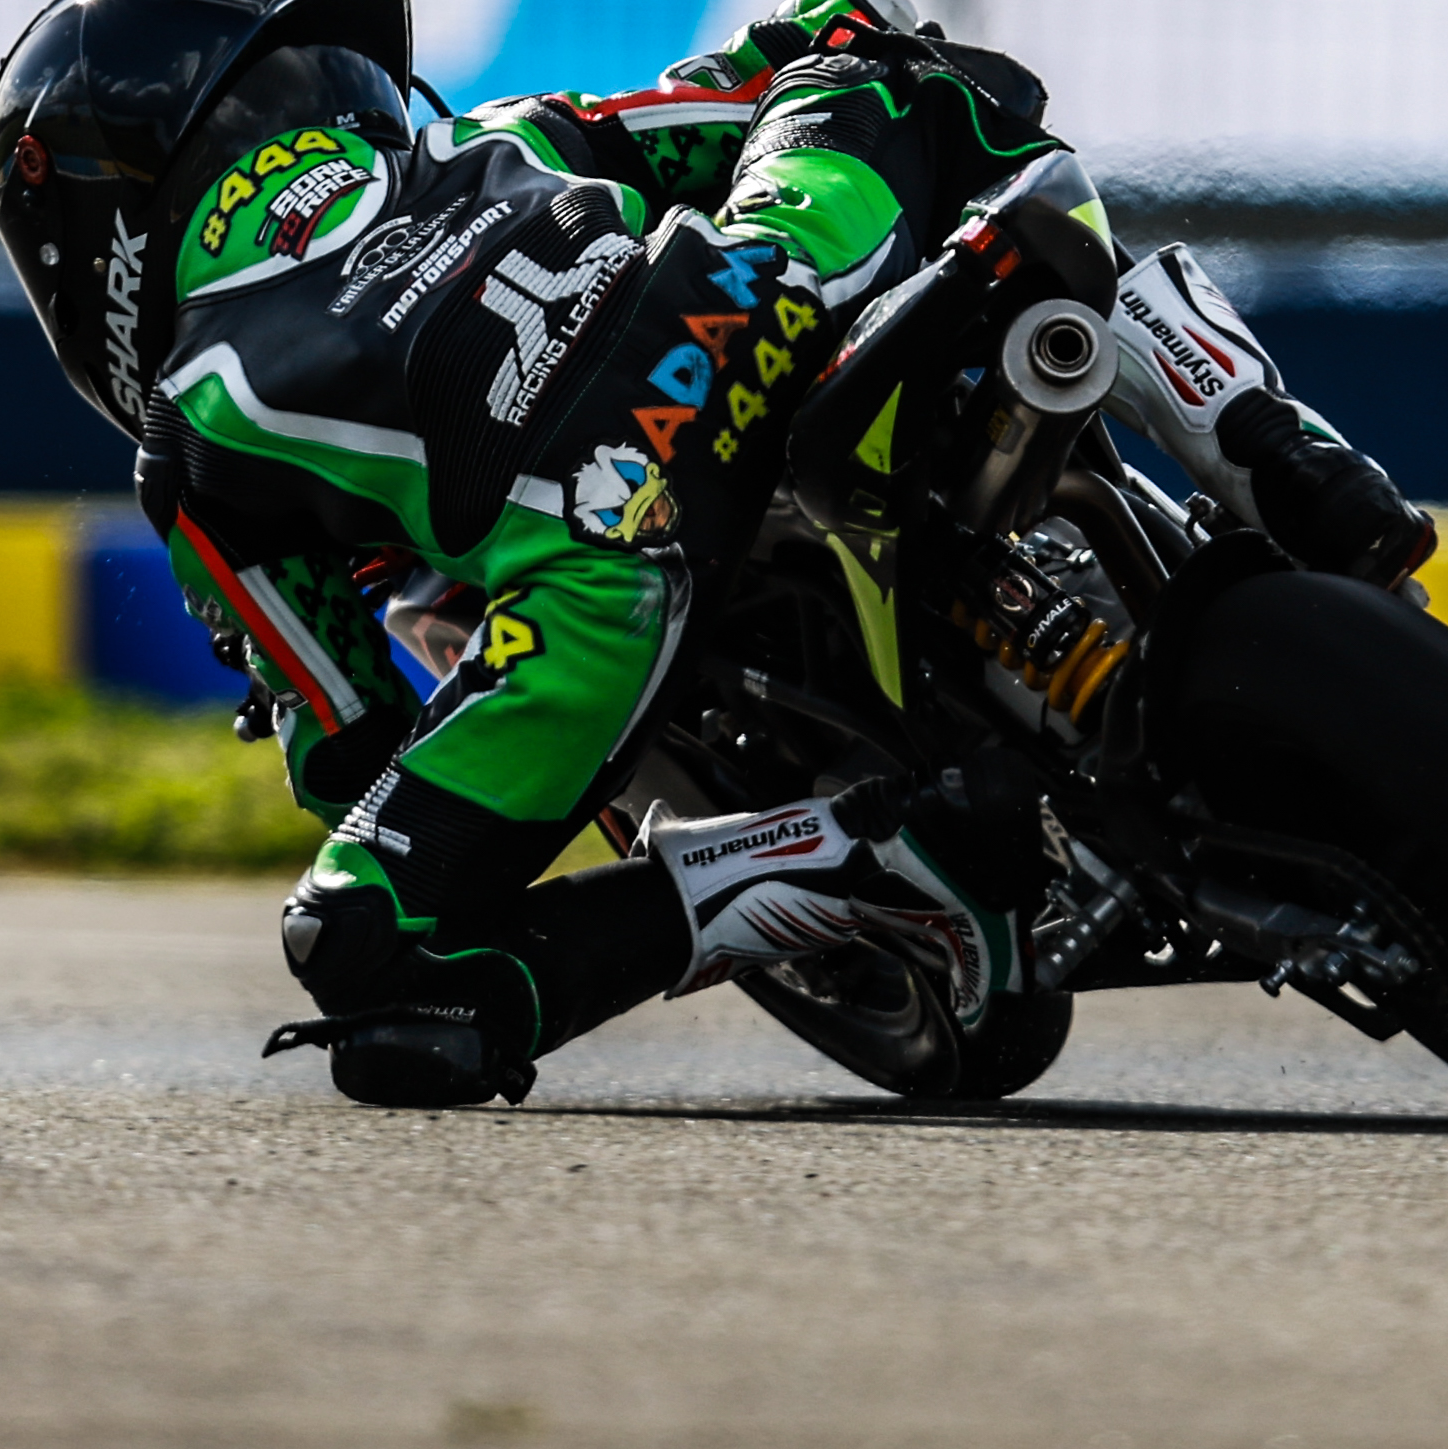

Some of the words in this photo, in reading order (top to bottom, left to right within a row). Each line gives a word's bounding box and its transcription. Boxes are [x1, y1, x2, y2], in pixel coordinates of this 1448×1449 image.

[203, 130, 340, 251] #444
[269, 159, 352, 219] BORN
[294, 167, 371, 219] RACE
[381, 200, 513, 330] MOTORSPORT
[384, 248, 404, 265] DE
[411, 234, 458, 278] LOISIRS
[105, 207, 149, 424] SHARK
[630, 244, 777, 465] ADAM
[1119, 290, 1225, 398] Stylmartin
[507, 338, 568, 427] RACING
[712, 293, 820, 463] #444
[1027, 598, 1073, 648] OHVALE
[682, 816, 820, 867] Stylmartin
